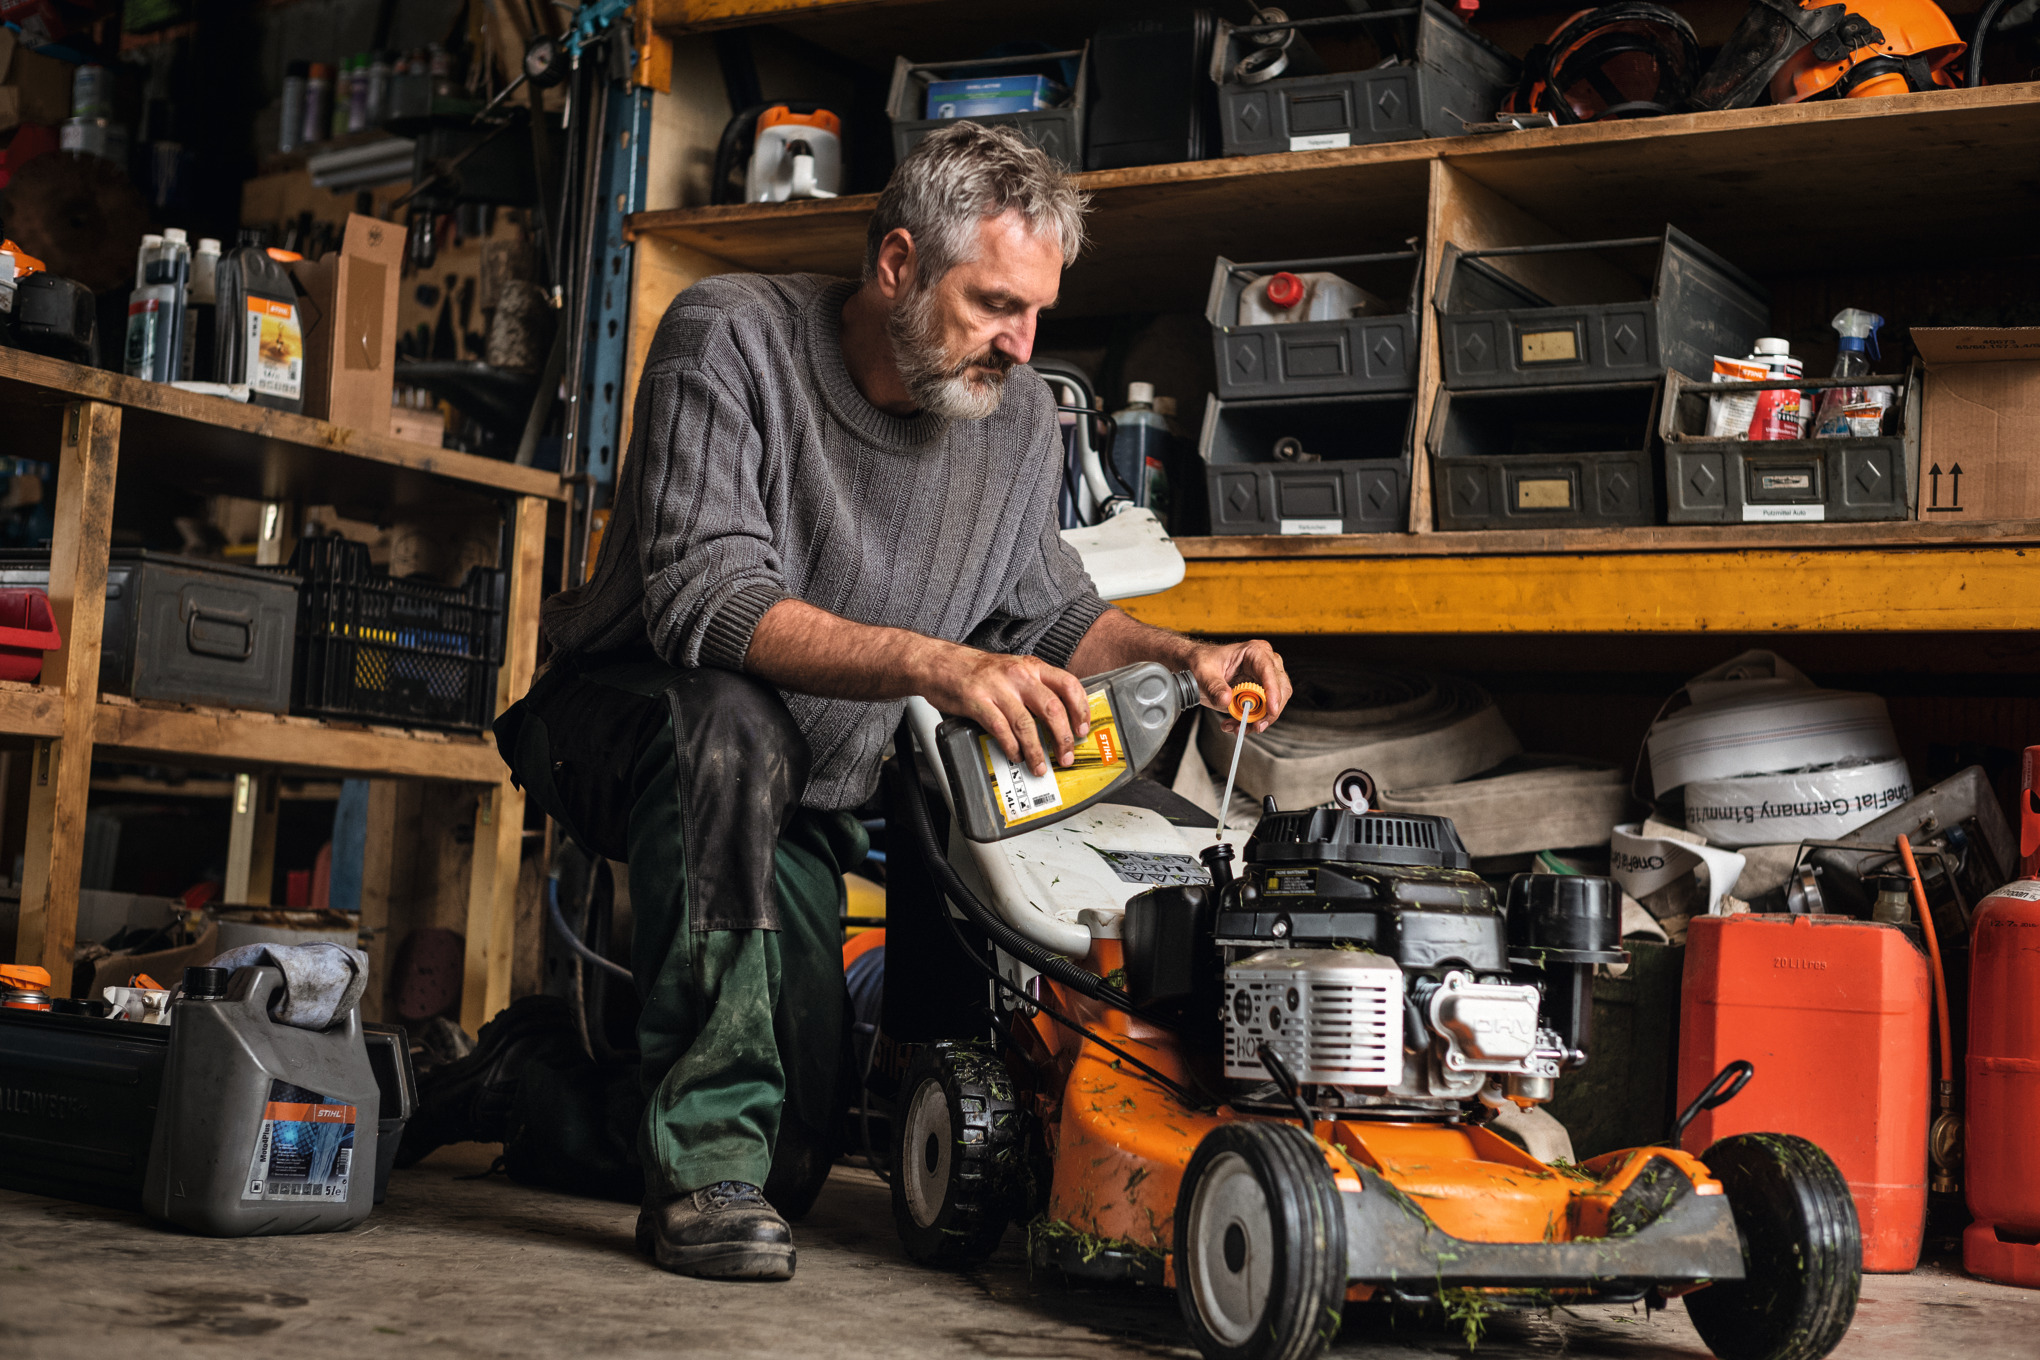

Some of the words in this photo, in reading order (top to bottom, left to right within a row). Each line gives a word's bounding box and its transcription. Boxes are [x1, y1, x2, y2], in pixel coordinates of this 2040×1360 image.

[1742, 368, 1764, 379] STIHL
[1099, 733, 1114, 762] STIHL
[1759, 798, 1850, 819] Germany
[1472, 1018, 1532, 1035] OHV
[318, 1109, 341, 1118] STIHL
[260, 1123, 271, 1163] Moto4Plus
